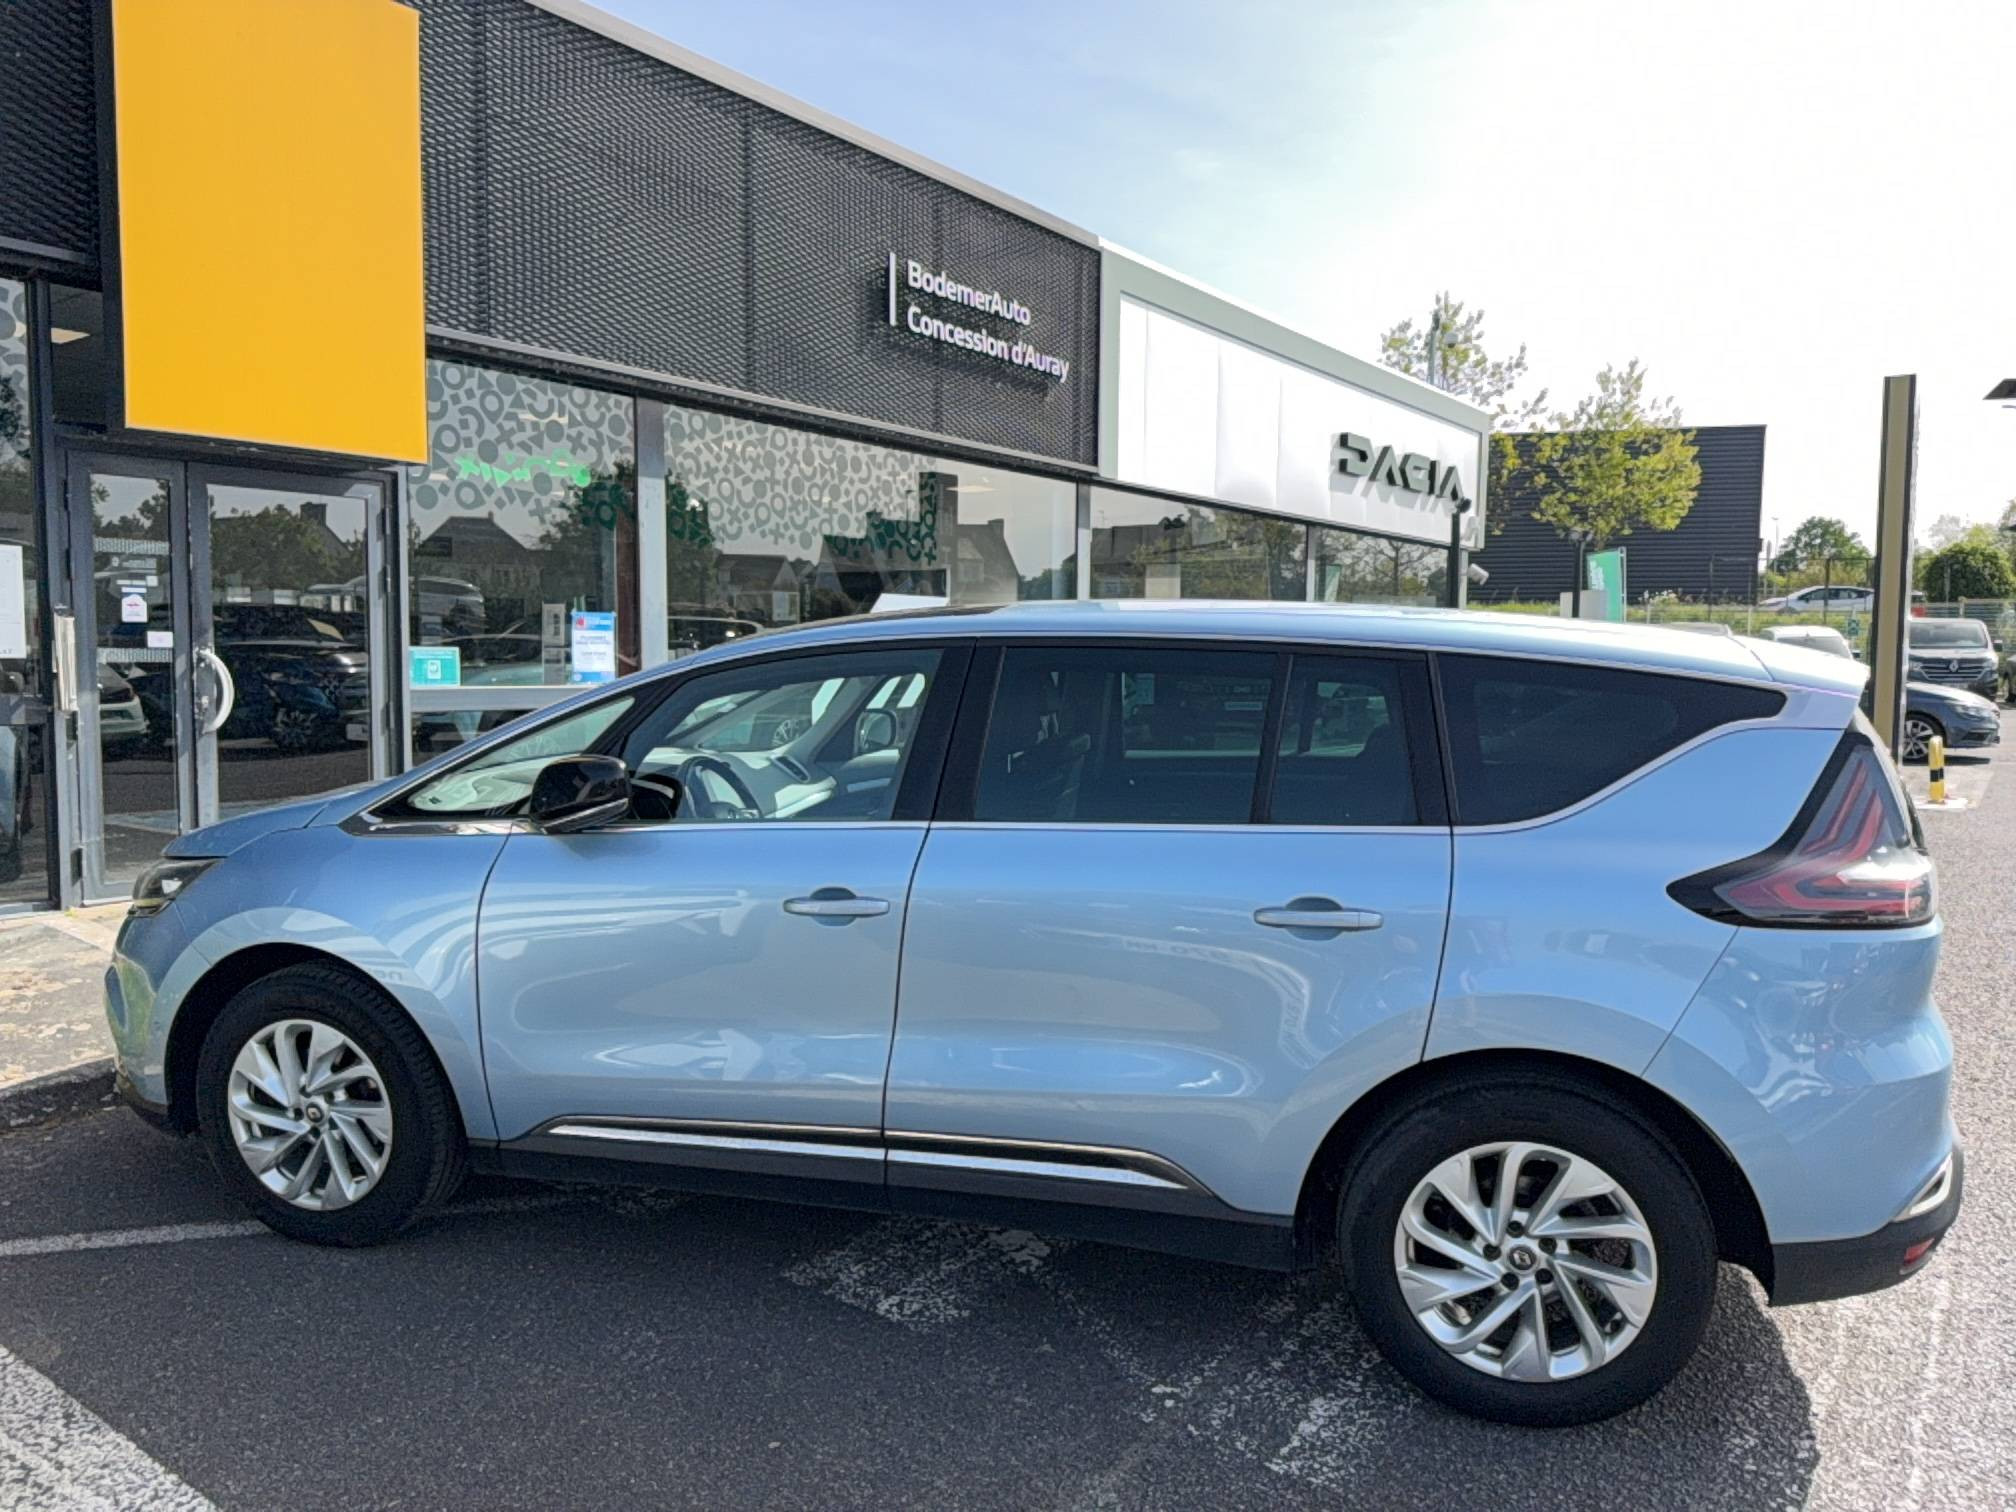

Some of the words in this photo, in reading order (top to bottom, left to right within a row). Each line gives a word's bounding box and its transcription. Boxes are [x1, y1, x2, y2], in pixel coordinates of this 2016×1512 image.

[907, 259, 1031, 326] BodemerAuto
[907, 305, 1009, 361] Concession
[1011, 341, 1070, 383] d'Auray
[1338, 431, 1465, 501] DACIA
